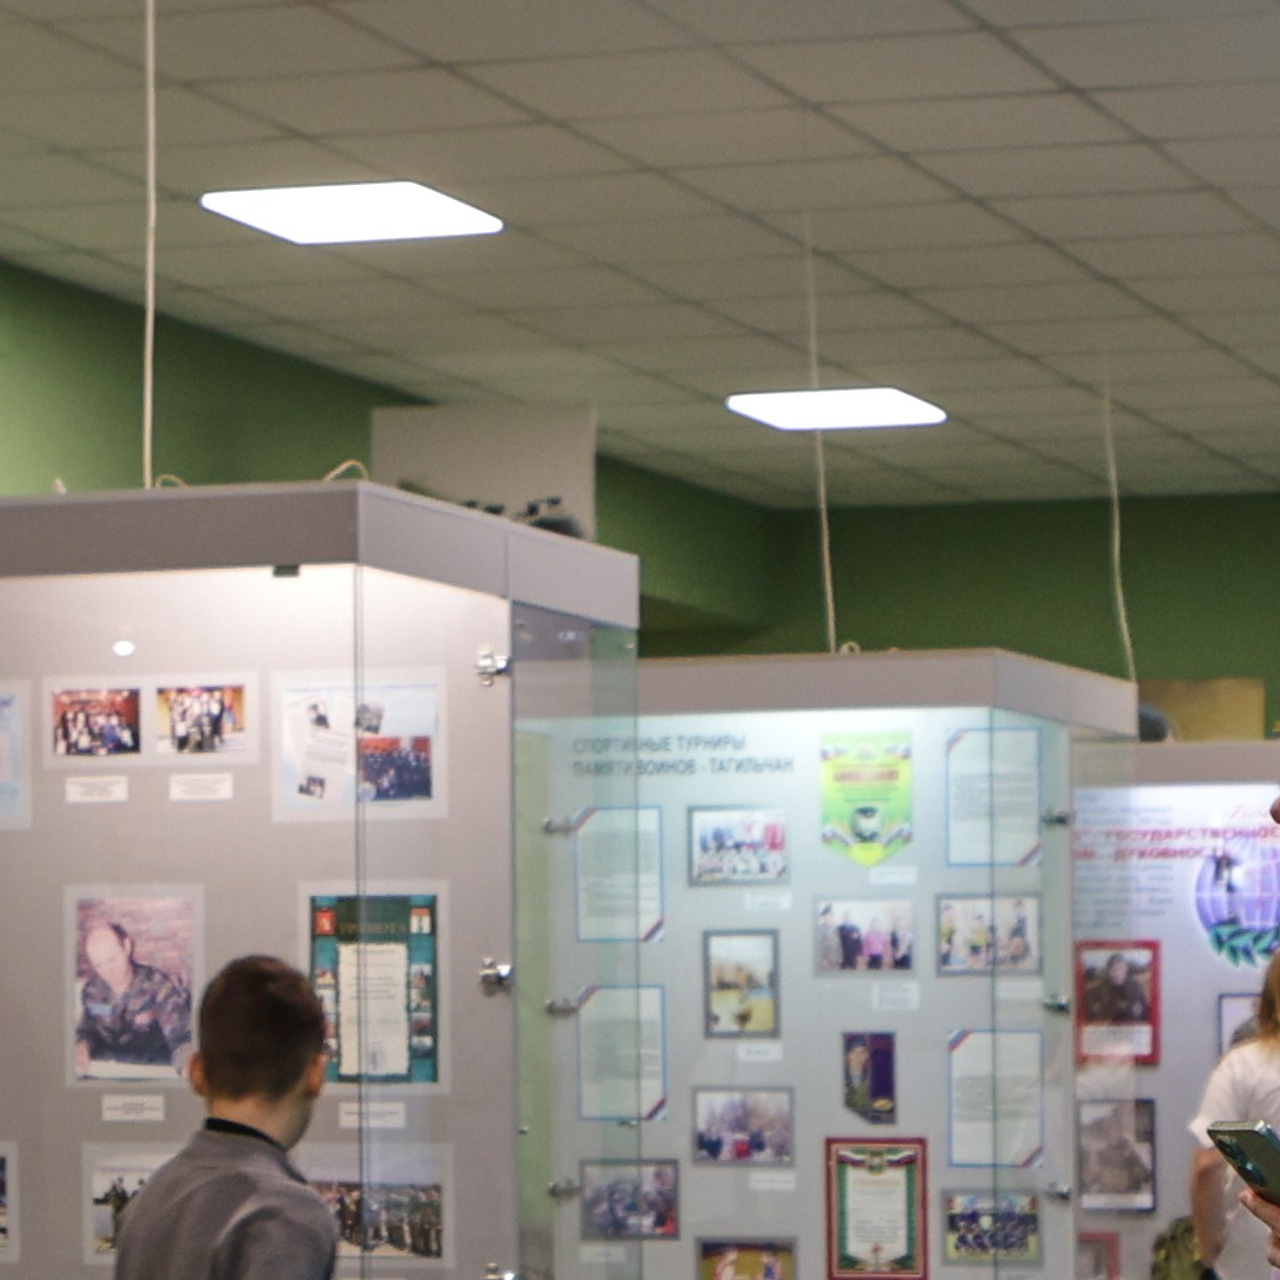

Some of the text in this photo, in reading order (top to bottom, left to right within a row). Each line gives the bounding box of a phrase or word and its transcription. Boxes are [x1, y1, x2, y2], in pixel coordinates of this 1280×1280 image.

[677, 735, 746, 750] ТУРНИРЫ
[635, 759, 696, 775] ВОИНОВ
[709, 756, 794, 773] ТАГИЛЬЧАН
